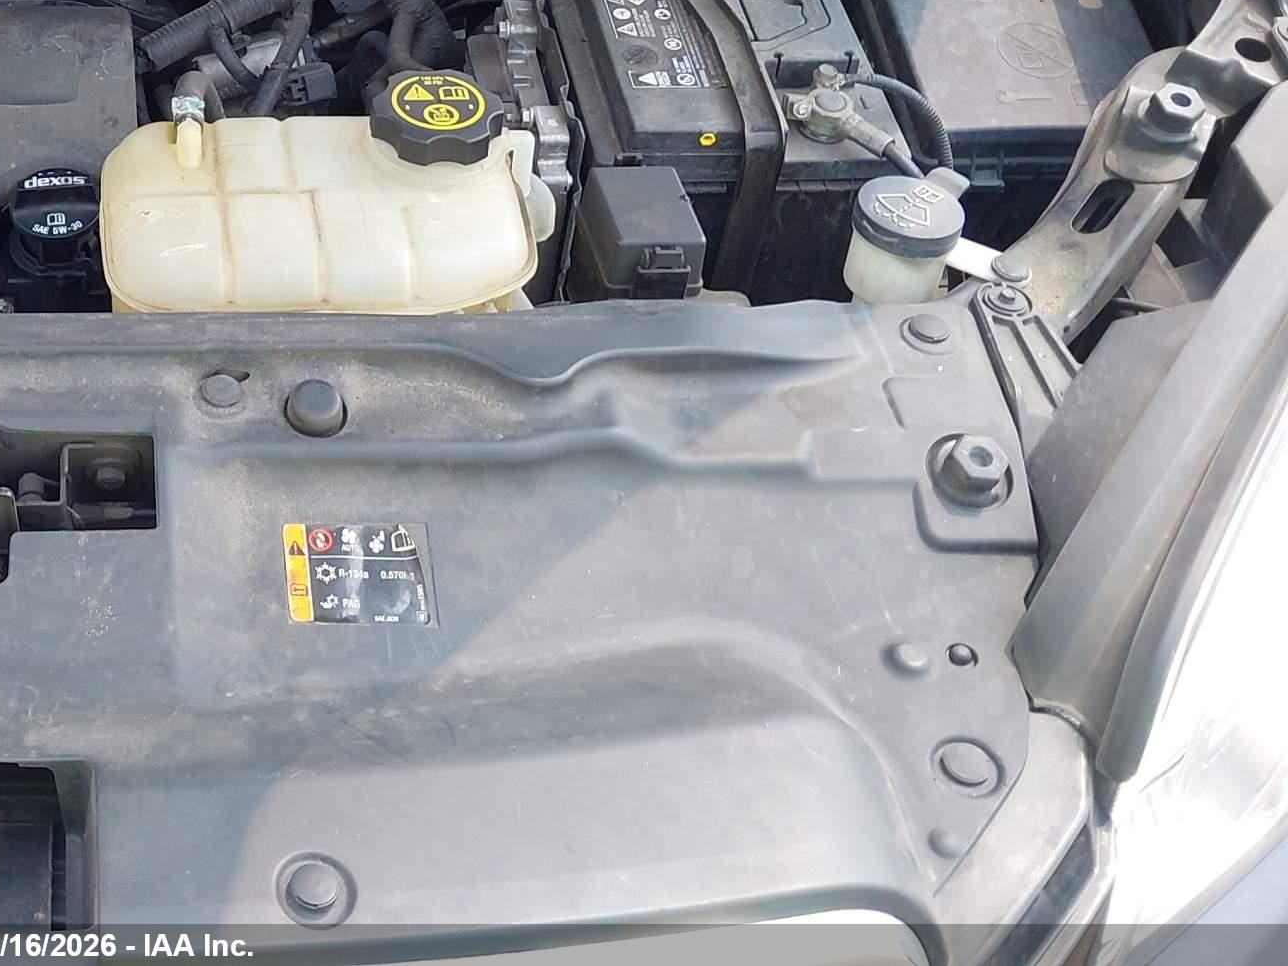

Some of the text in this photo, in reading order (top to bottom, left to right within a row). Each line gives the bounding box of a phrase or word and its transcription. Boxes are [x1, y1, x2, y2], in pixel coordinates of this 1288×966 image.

[24, 175, 87, 188] dexos
[32, 220, 83, 235] SAE 5W-30
[341, 544, 360, 552] AUTO
[338, 568, 369, 579] R-134a
[342, 598, 360, 608] PAG
